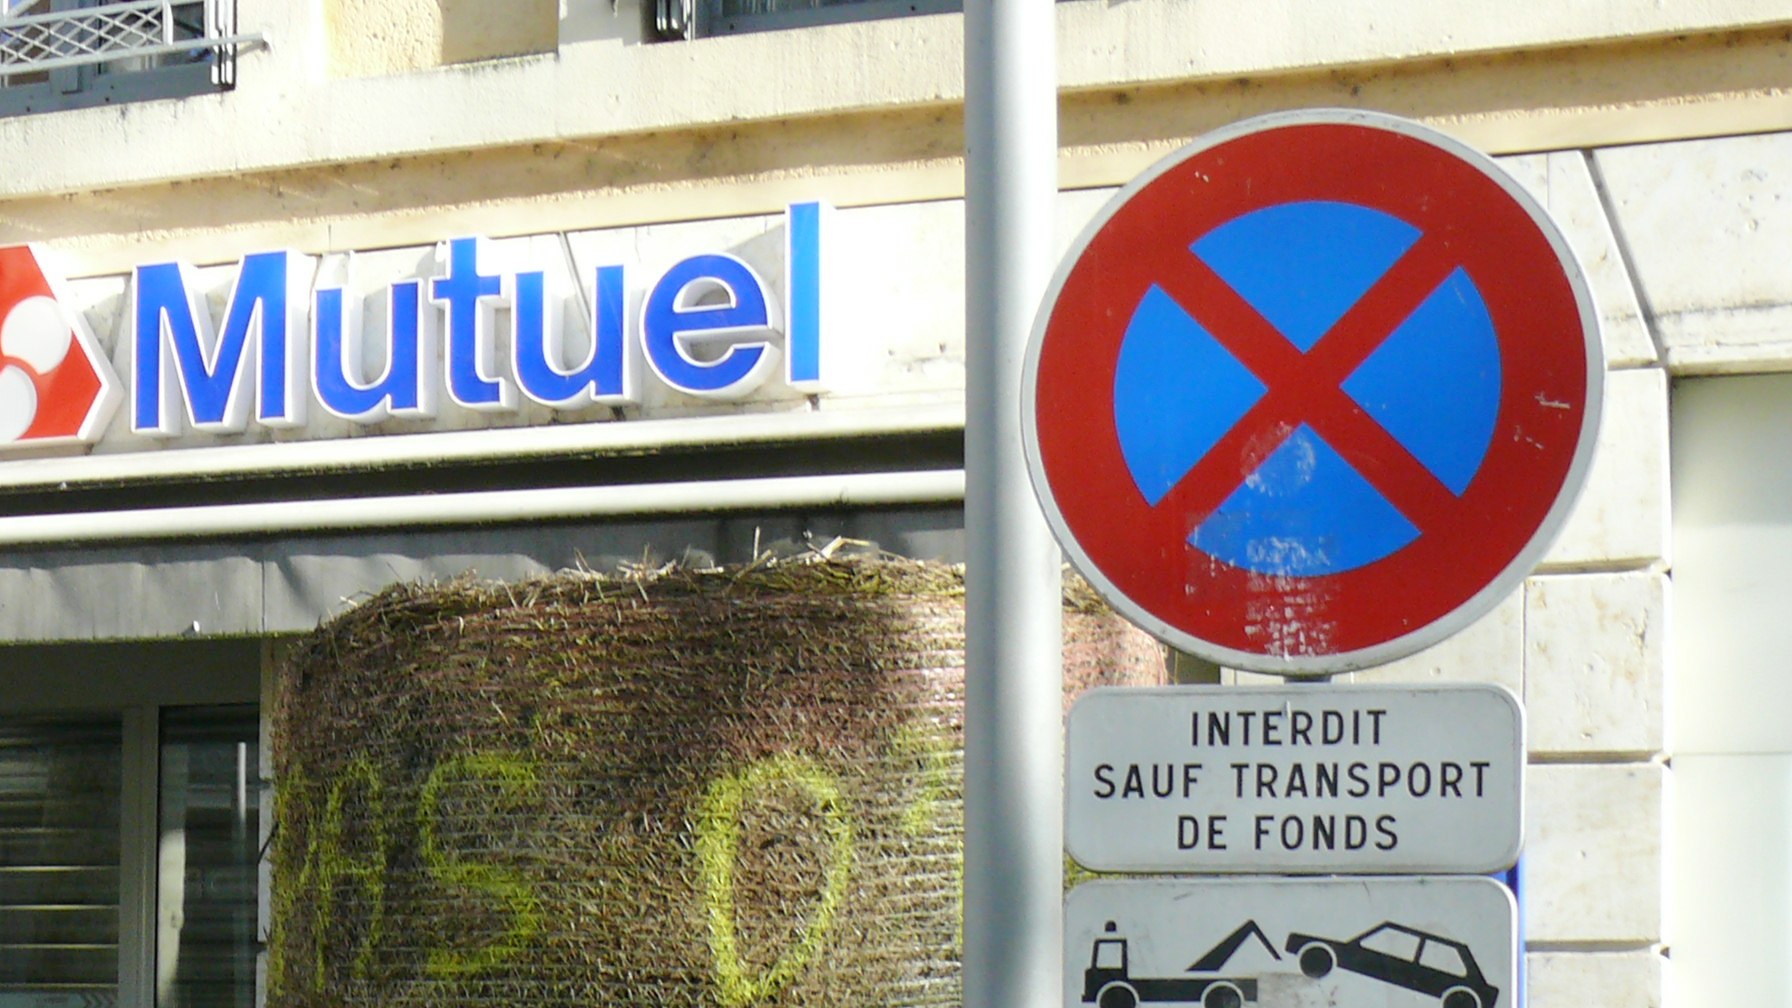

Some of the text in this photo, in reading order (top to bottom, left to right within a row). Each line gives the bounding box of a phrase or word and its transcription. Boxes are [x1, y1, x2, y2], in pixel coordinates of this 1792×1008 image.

[132, 201, 821, 433] Mutuel
[1190, 709, 1388, 747] INTERDIT
[1093, 761, 1491, 800] SAUF TRANSPORT
[1177, 814, 1399, 851] DE FONDS
